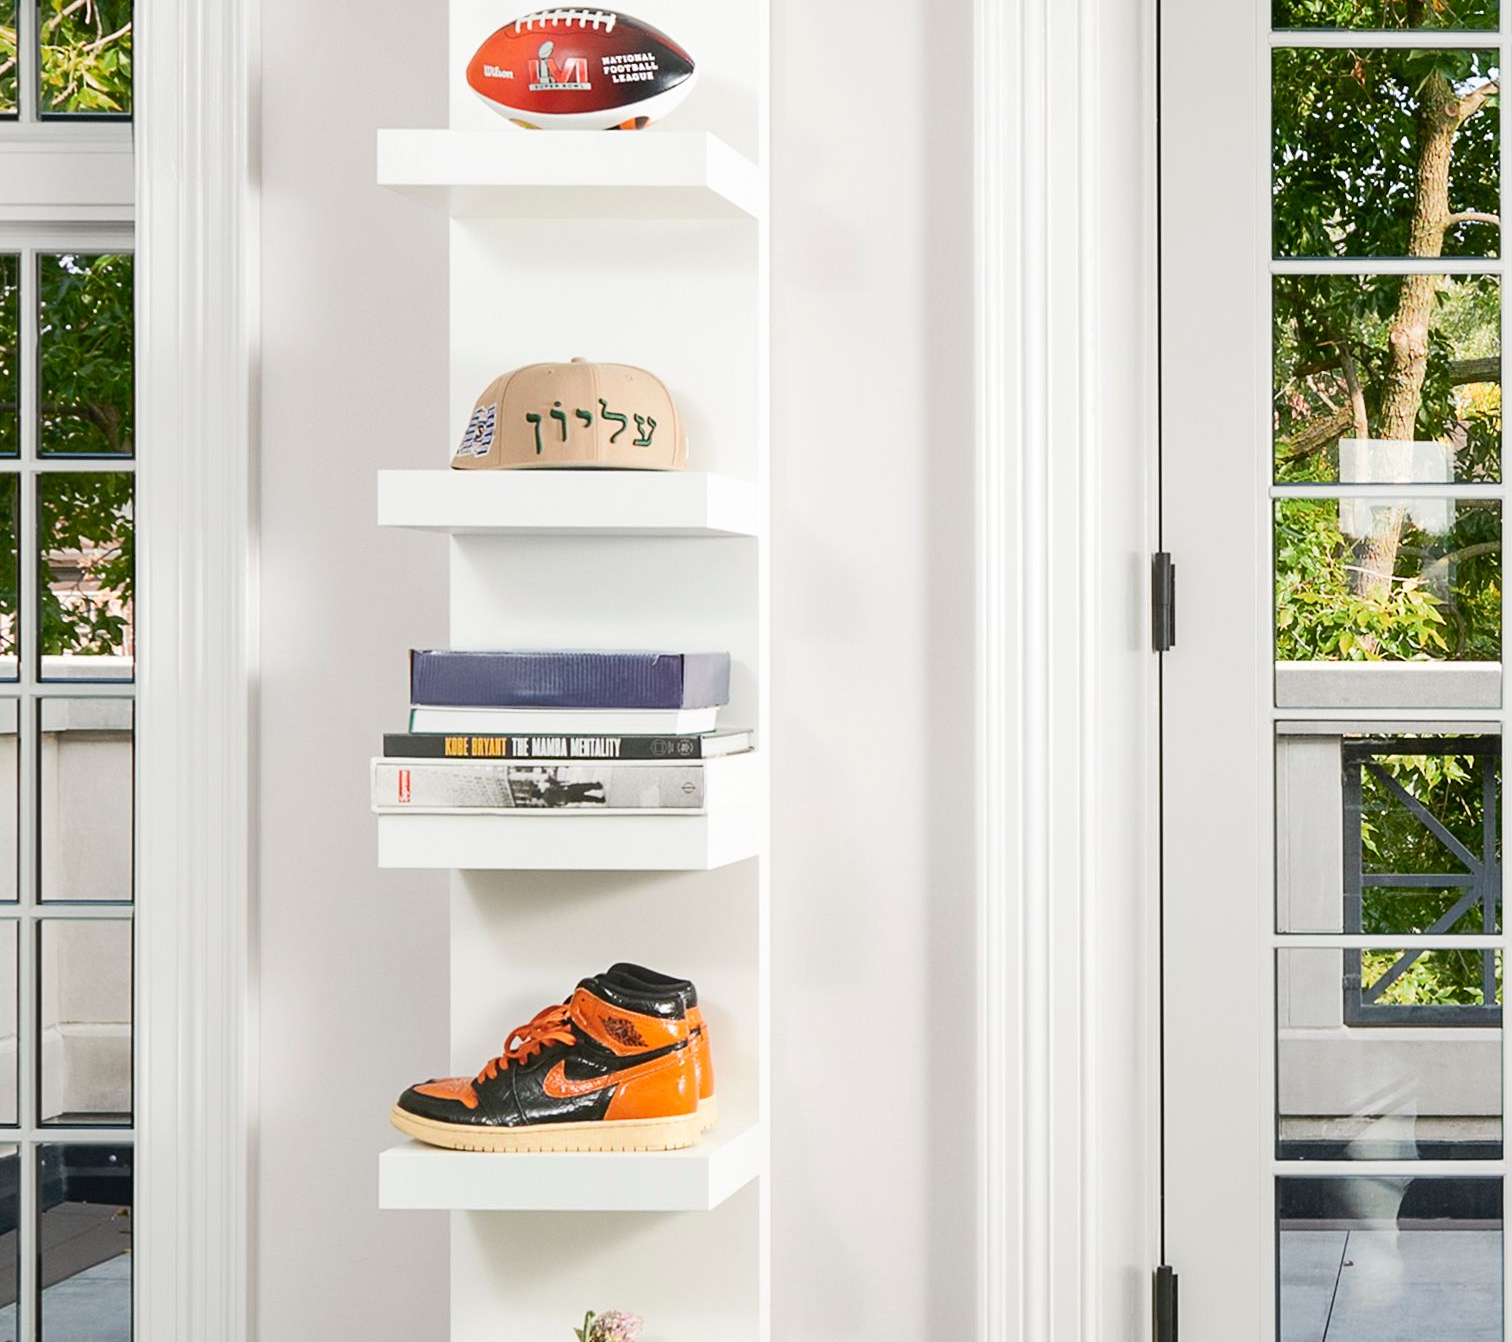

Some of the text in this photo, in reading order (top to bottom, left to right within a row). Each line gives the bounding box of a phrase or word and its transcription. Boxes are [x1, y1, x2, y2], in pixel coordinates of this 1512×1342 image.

[601, 52, 656, 65] NATIONAL
[483, 65, 515, 80] Wilson
[603, 61, 659, 75] FOOTBALL
[612, 71, 655, 84] LEAGUE
[445, 737, 621, 758] KOBE BRYANT THE MAMBA MENTALITY
